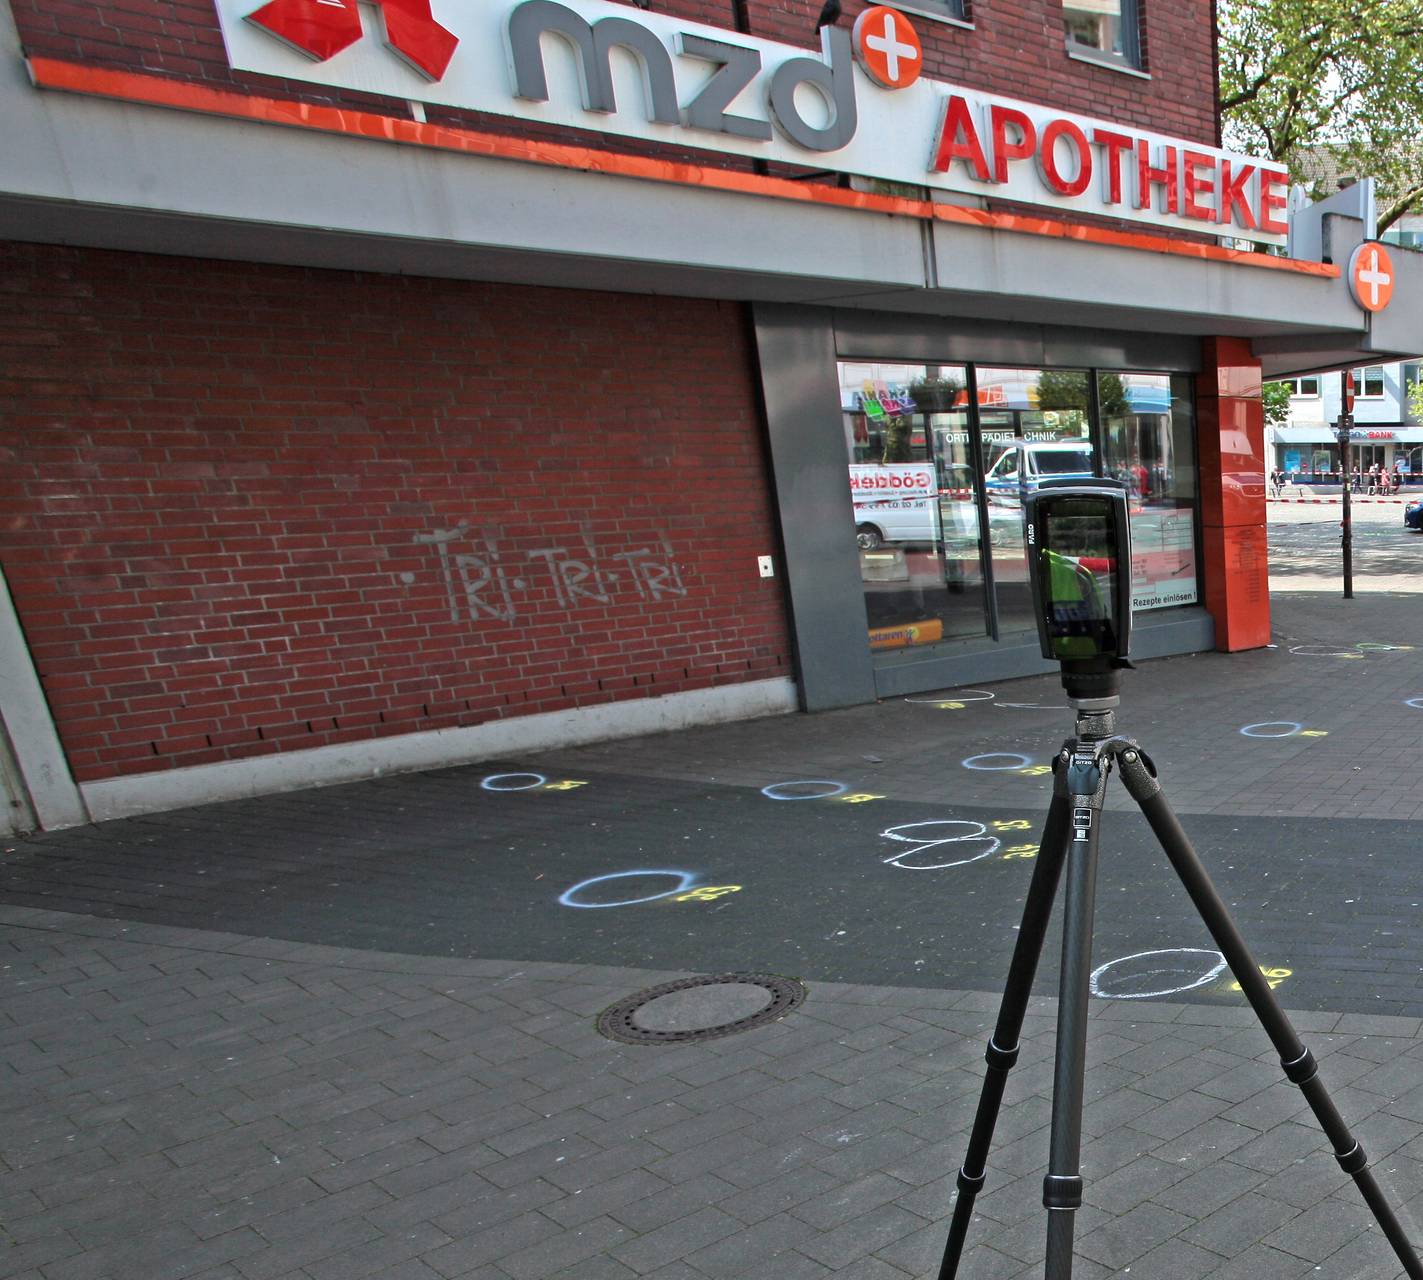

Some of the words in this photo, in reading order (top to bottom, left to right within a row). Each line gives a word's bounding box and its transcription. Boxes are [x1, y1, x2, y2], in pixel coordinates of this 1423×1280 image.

[508, 0, 857, 152] mzd
[928, 95, 1289, 234] APOTHEKE
[1027, 523, 1036, 545] FARO
[1133, 597, 1161, 608] Rezepte
[1162, 593, 1192, 605] einlösen
